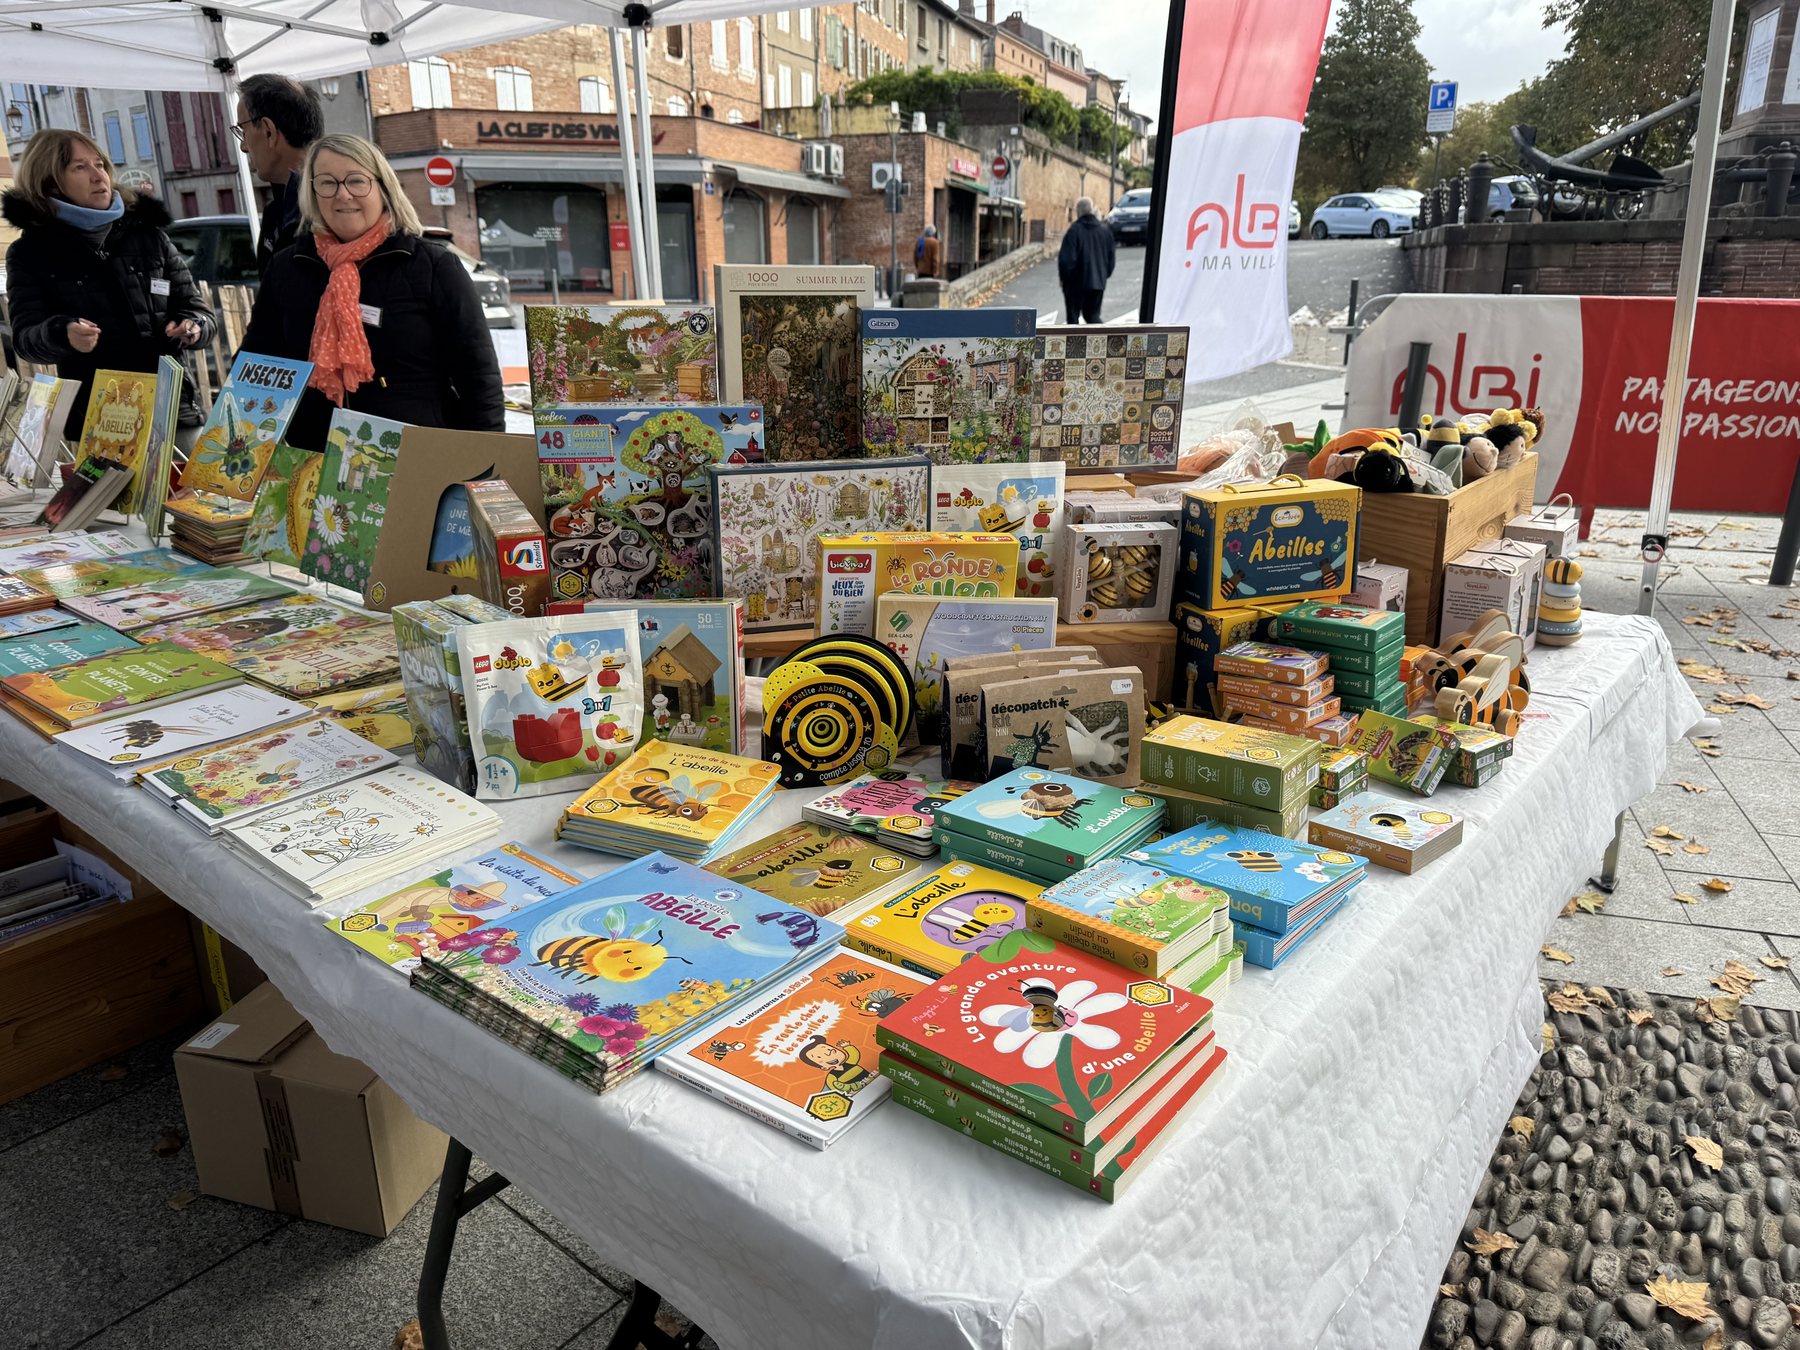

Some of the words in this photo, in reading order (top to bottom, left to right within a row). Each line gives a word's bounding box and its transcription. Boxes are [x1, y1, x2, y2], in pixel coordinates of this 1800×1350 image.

[1437, 87, 1450, 107] P
[478, 121, 502, 137] LA
[505, 122, 549, 138] CLEF
[552, 123, 586, 139] DES
[589, 123, 620, 140] VIN
[1202, 255, 1232, 271] MA
[1240, 255, 1276, 271] VILL
[748, 272, 778, 283] 1000
[796, 276, 838, 285] SUMMER
[840, 276, 866, 285] HAZE
[870, 319, 898, 328] Gibsons
[238, 361, 296, 391] INSECTES
[1622, 376, 1800, 406] PATAGEON
[99, 419, 134, 436] ABEILLES
[1614, 411, 1663, 435] NO
[541, 430, 565, 449] 48
[573, 429, 605, 439] GIANT
[953, 496, 984, 509] duplo
[1185, 520, 1206, 537] Abeilles
[534, 540, 542, 569] Schmidt
[1249, 535, 1325, 564] Abeilles
[893, 573, 911, 588] La
[911, 558, 994, 581] RONDE
[832, 580, 854, 590] JEUX
[833, 589, 844, 597] DU
[844, 589, 864, 598] BIEN
[886, 579, 999, 598] llen
[912, 582, 927, 594] du
[697, 613, 713, 624] 50
[934, 613, 981, 621] WOODCRAFT
[981, 614, 1034, 622] CONSTRUCTION
[1012, 626, 1021, 634] 30
[1022, 626, 1044, 634] Pieces
[48, 641, 88, 661] CONTES
[886, 641, 909, 655] 8+
[1181, 633, 1209, 652] Abeilles
[9, 648, 47, 669] PLANÈTE
[494, 656, 532, 671] duplo
[124, 664, 167, 684] CONTES
[404, 655, 441, 687] COLOR
[84, 671, 134, 693] PLANÈTE
[792, 687, 816, 702] Petite
[818, 684, 846, 696] Abeille
[955, 691, 979, 704] déc
[955, 703, 975, 718] kit
[991, 697, 1058, 715] décopatch
[958, 715, 972, 725] MINI
[992, 713, 1012, 728] kit
[995, 727, 1009, 737] MINI
[1171, 721, 1211, 742] HAPPY
[863, 736, 873, 747] 10
[669, 758, 729, 775] L'abeille
[673, 751, 684, 759] Le
[685, 753, 708, 764] cycle
[708, 756, 719, 764] de
[732, 761, 743, 769] vie
[818, 764, 849, 781] compte
[365, 781, 392, 800] JAUNE
[392, 793, 419, 813] COMME
[737, 860, 752, 869] MES
[753, 850, 771, 862] AMIS
[771, 846, 781, 854] DU
[780, 835, 806, 848] JARDIN
[1160, 836, 1198, 854] bonjour
[1180, 833, 1232, 857] abeille
[757, 841, 829, 877] abeille
[478, 857, 495, 871] La
[495, 862, 523, 880] visite
[521, 873, 537, 889] du
[1061, 878, 1089, 899] Petite
[1088, 862, 1121, 888] abeille
[1083, 885, 1097, 898] au
[1096, 871, 1128, 895] jardin
[684, 892, 698, 902] La
[697, 897, 731, 917] petite
[894, 881, 966, 919] L'abeille
[637, 891, 740, 941] ABEILLE
[1063, 930, 1090, 949] abeille
[1069, 923, 1095, 942] jardin
[1095, 935, 1109, 945] au
[858, 939, 893, 962] L'abeille
[1090, 942, 1116, 960] Petite
[986, 962, 1078, 983] aventure
[527, 974, 540, 987] belle
[538, 983, 566, 999] histoire
[544, 995, 565, 1007] cycle
[736, 1016, 748, 1026] LES
[746, 995, 779, 1022] DÉCOUVERTES
[778, 991, 786, 1001] DE
[911, 1001, 939, 1026] Maggie
[938, 995, 950, 1007] Li
[960, 978, 987, 1026] grande
[1175, 1000, 1192, 1014] milan
[759, 1043, 778, 1057] En
[775, 1021, 803, 1044] route
[800, 1003, 822, 1024] chez
[777, 1041, 799, 1057] les
[796, 1014, 830, 1042] abeilles
[966, 1024, 986, 1044] La
[895, 1040, 918, 1059] Maggie
[1081, 1050, 1136, 1077] d'une
[1133, 1011, 1157, 1054] abeille
[898, 1070, 920, 1087] Maggie
[981, 1078, 1007, 1095] abeille
[970, 1081, 1002, 1101] aventure
[1007, 1091, 1026, 1105] d'une
[819, 1100, 839, 1114] 3+
[912, 1096, 936, 1115] Maggie
[1001, 1096, 1025, 1115] grande
[1024, 1109, 1037, 1119] La
[975, 1110, 1008, 1130] aventure
[986, 1107, 1013, 1125] abeille
[1008, 1126, 1032, 1143] grande
[1013, 1119, 1032, 1134] d'une
[992, 1138, 1024, 1159] aventure
[1003, 1136, 1030, 1153] abeille
[1032, 1138, 1044, 1148] La
[1025, 1155, 1050, 1172] grande
[1031, 1149, 1050, 1163] d'une
[1050, 1166, 1062, 1177] La
